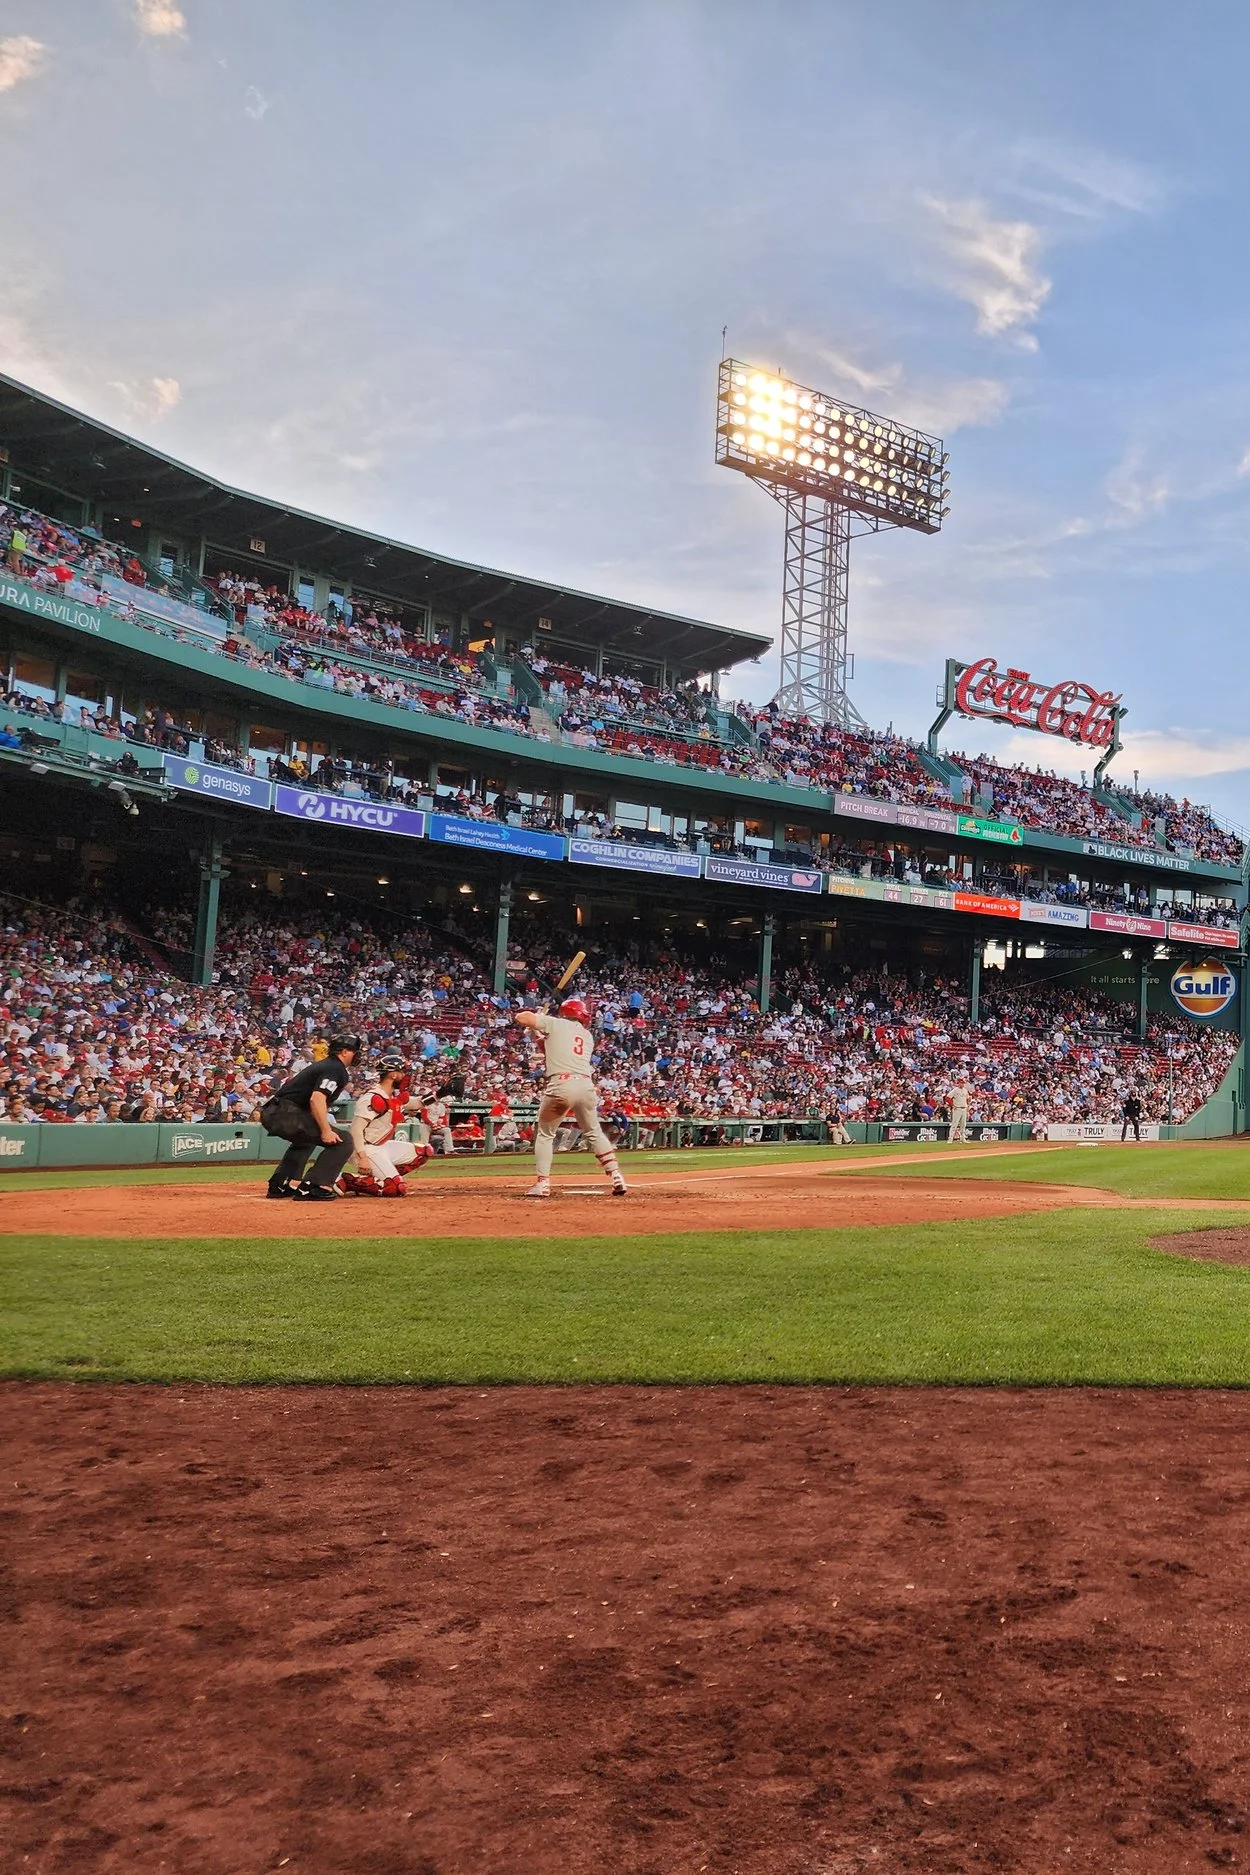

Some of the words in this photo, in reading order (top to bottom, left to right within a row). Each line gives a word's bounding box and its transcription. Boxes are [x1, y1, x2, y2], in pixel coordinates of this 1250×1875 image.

[34, 596, 101, 632] PAVILION
[956, 658, 1123, 748] Coca-Cola
[202, 773, 251, 797] genasys
[330, 802, 394, 826] HYCU
[841, 801, 863, 814] PITCH
[864, 805, 888, 818] BREAK
[984, 824, 1009, 833] OFFICIAL
[445, 832, 460, 841] Beth
[460, 835, 475, 845] Israel
[506, 842, 528, 853] Medical
[528, 846, 548, 856] Center
[571, 842, 626, 858] COGHLIN
[628, 849, 699, 867] COMPANIES
[1098, 845, 1129, 860] BLACK
[1130, 851, 1155, 865] LIVES
[1156, 856, 1190, 871] MATTER
[711, 863, 759, 880] vineyard
[760, 870, 788, 882] vines
[888, 892, 898, 900] 44
[913, 895, 924, 904] 27
[956, 899, 972, 907] BANK
[981, 902, 1007, 911] AMERICA
[1048, 910, 1080, 922] AMAZING
[1170, 926, 1205, 940] Safelite
[1111, 976, 1136, 984] starts
[1173, 976, 1231, 995] Gulf
[572, 1034, 585, 1056] 3
[320, 1078, 338, 1094] 10
[1084, 1127, 1105, 1135] TRULY
[177, 1138, 202, 1151] ACE
[205, 1138, 251, 1155] TICKET
